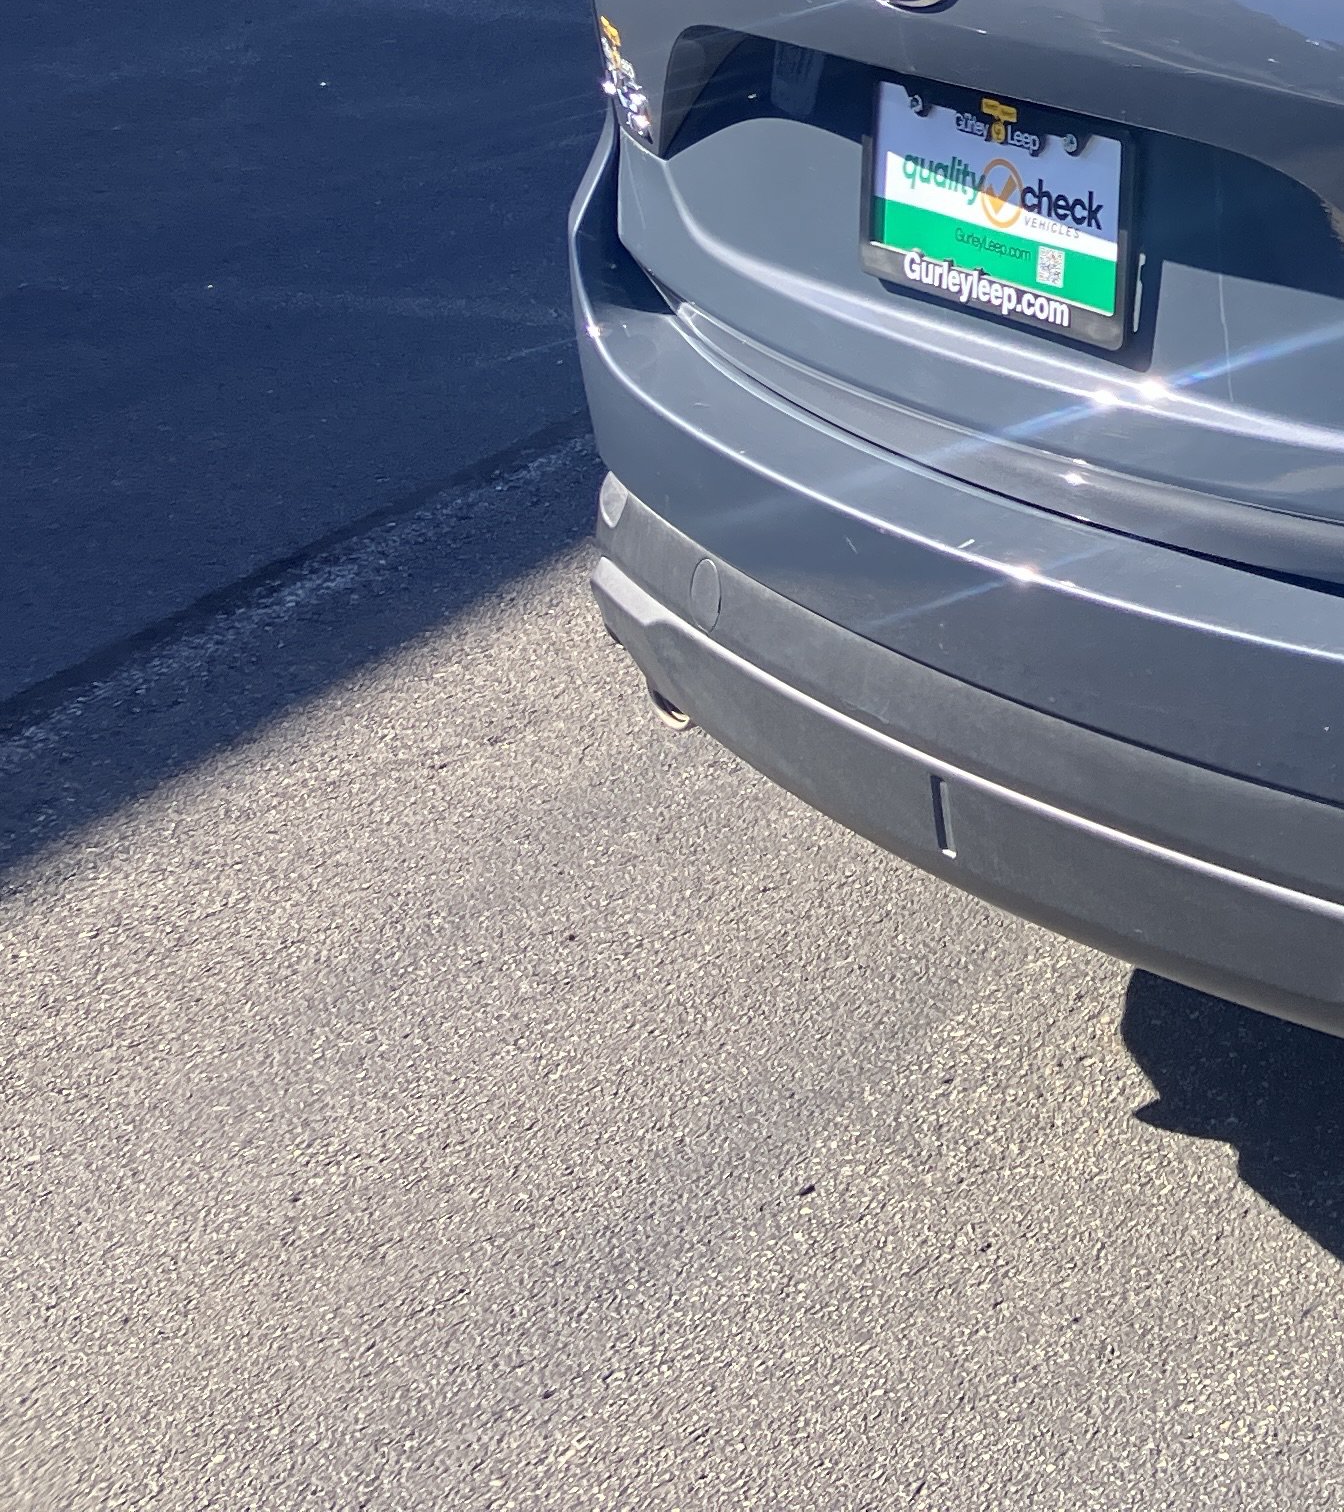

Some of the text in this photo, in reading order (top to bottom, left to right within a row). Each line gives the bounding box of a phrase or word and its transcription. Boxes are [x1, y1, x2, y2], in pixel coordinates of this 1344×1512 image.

[1007, 124, 1040, 154] Leep
[903, 154, 1103, 229] quality check
[1024, 215, 1080, 238] VEHICLES
[903, 251, 1071, 327] Gurleyleep.com
